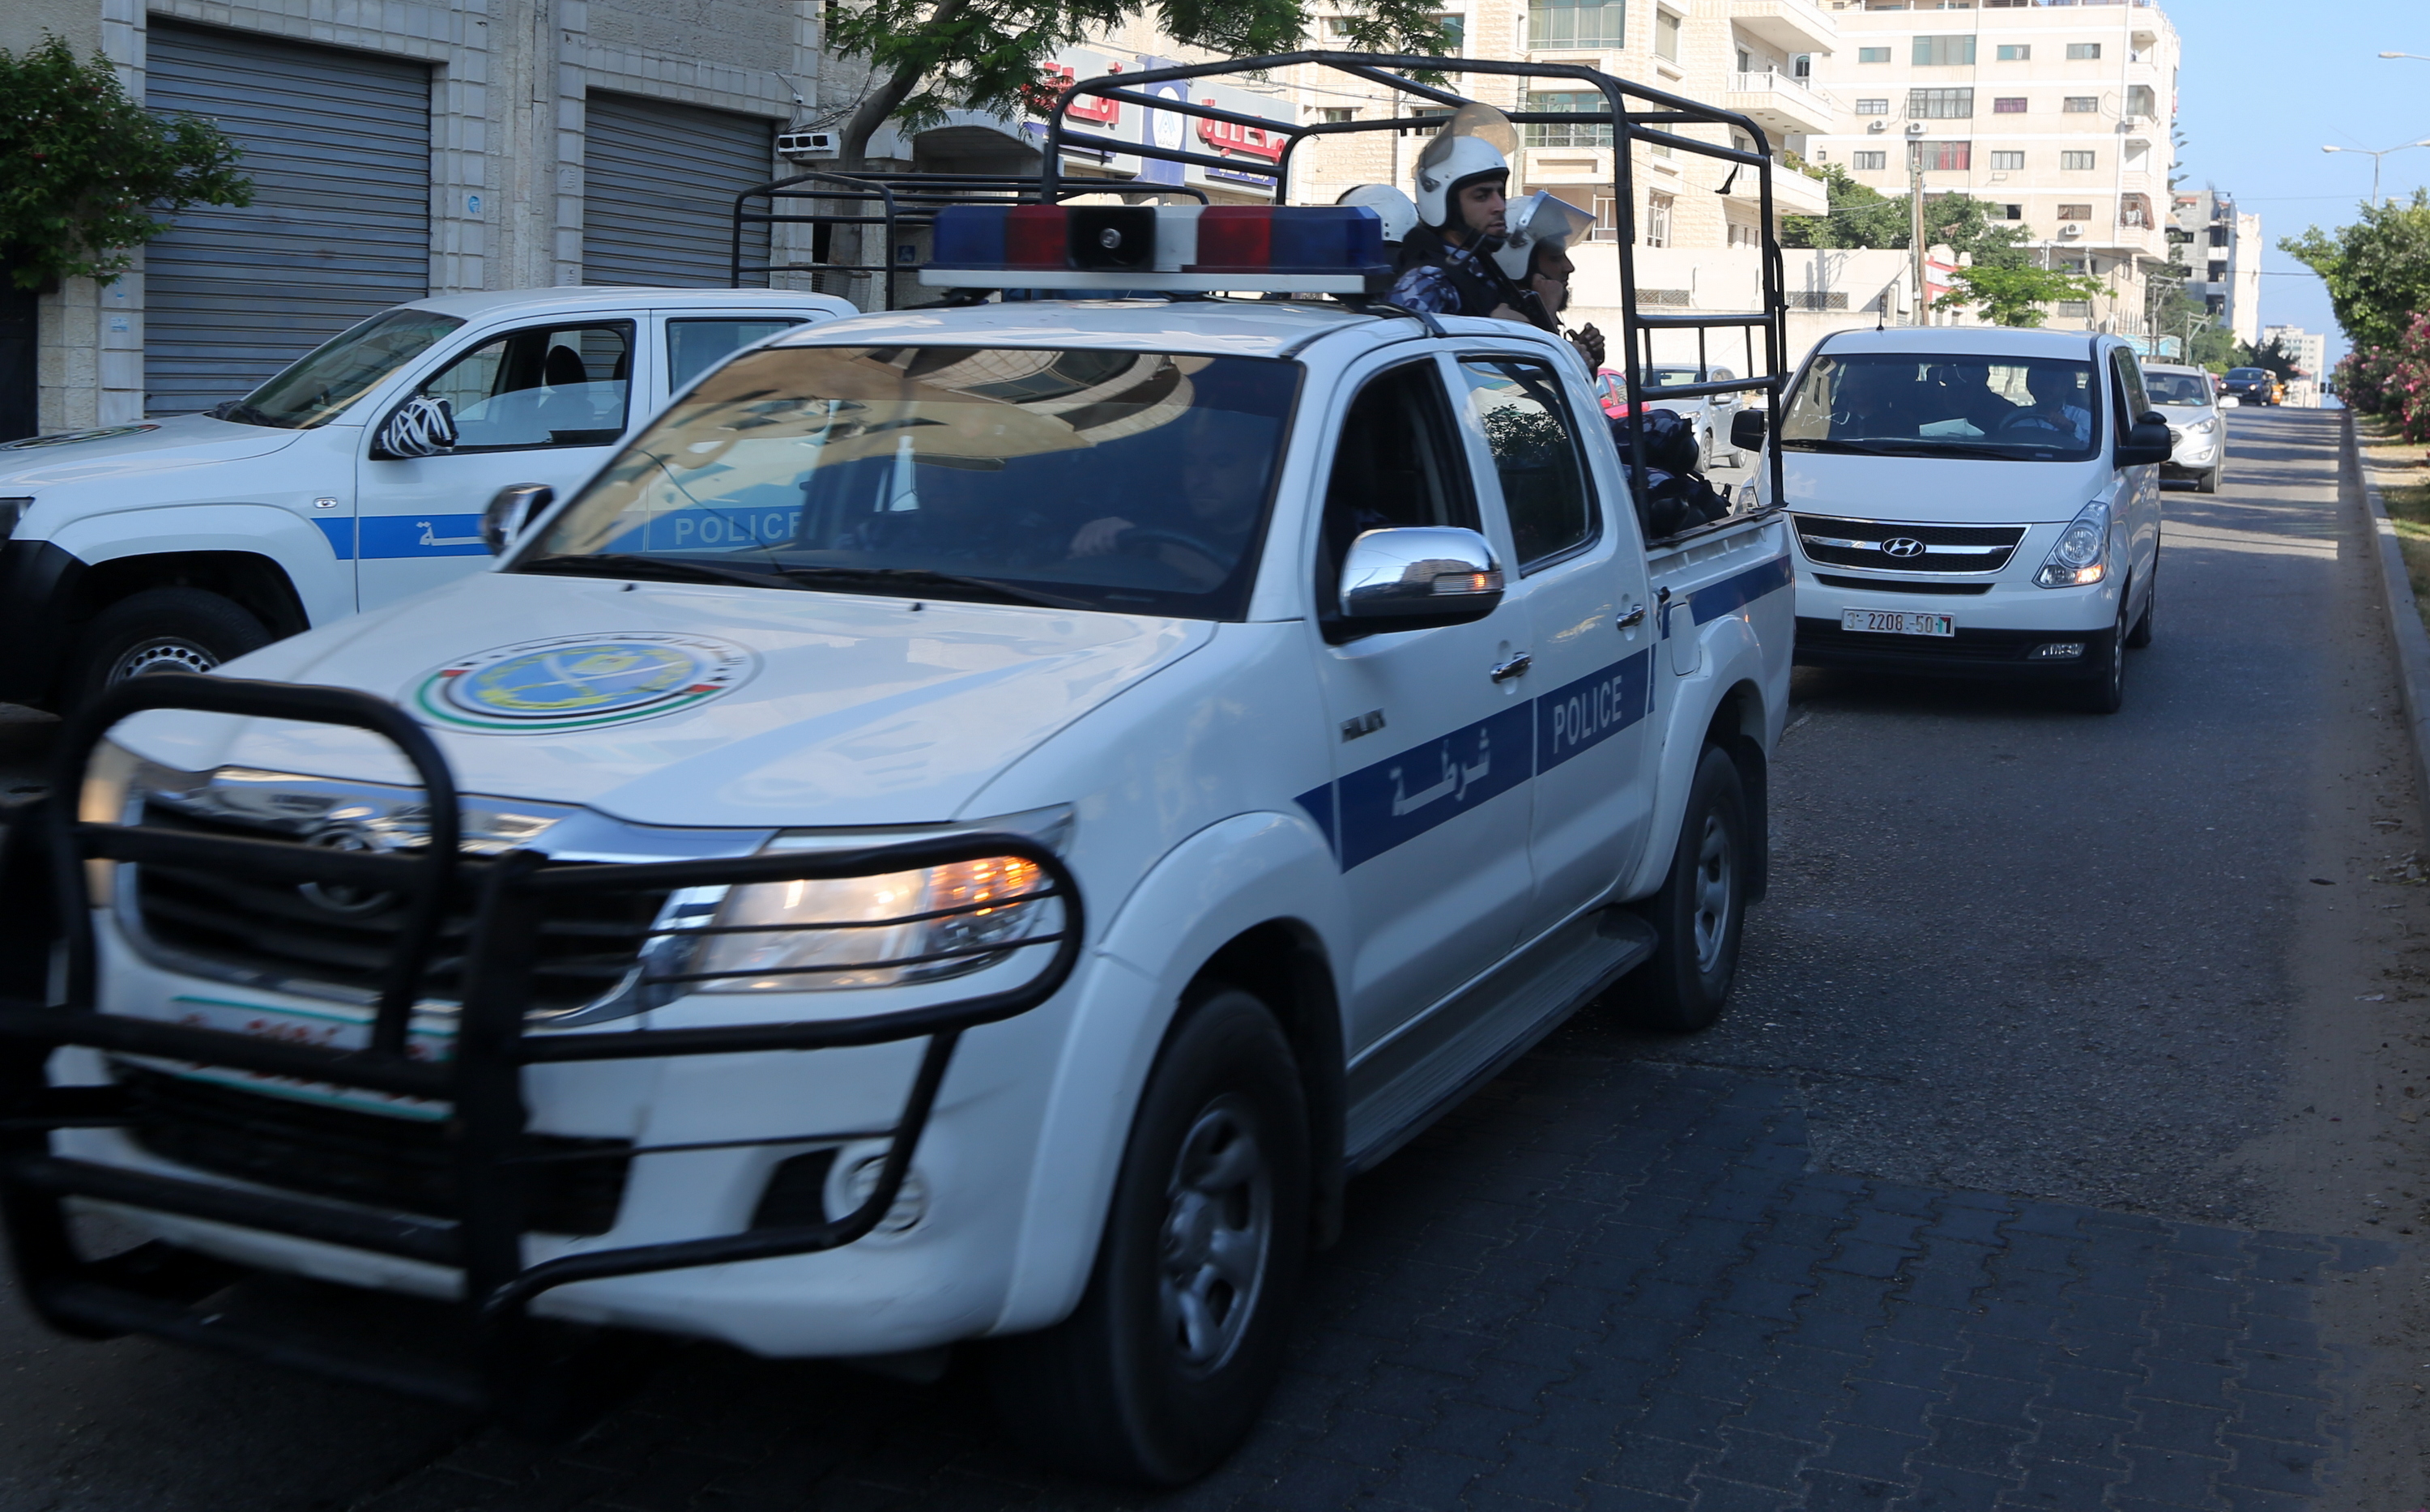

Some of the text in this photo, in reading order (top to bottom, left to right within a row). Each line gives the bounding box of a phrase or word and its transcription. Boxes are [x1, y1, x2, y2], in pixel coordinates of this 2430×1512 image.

[675, 511, 803, 545] POLICE
[1554, 675, 1622, 755] POLICE
[1389, 727, 1490, 816] شرطة
